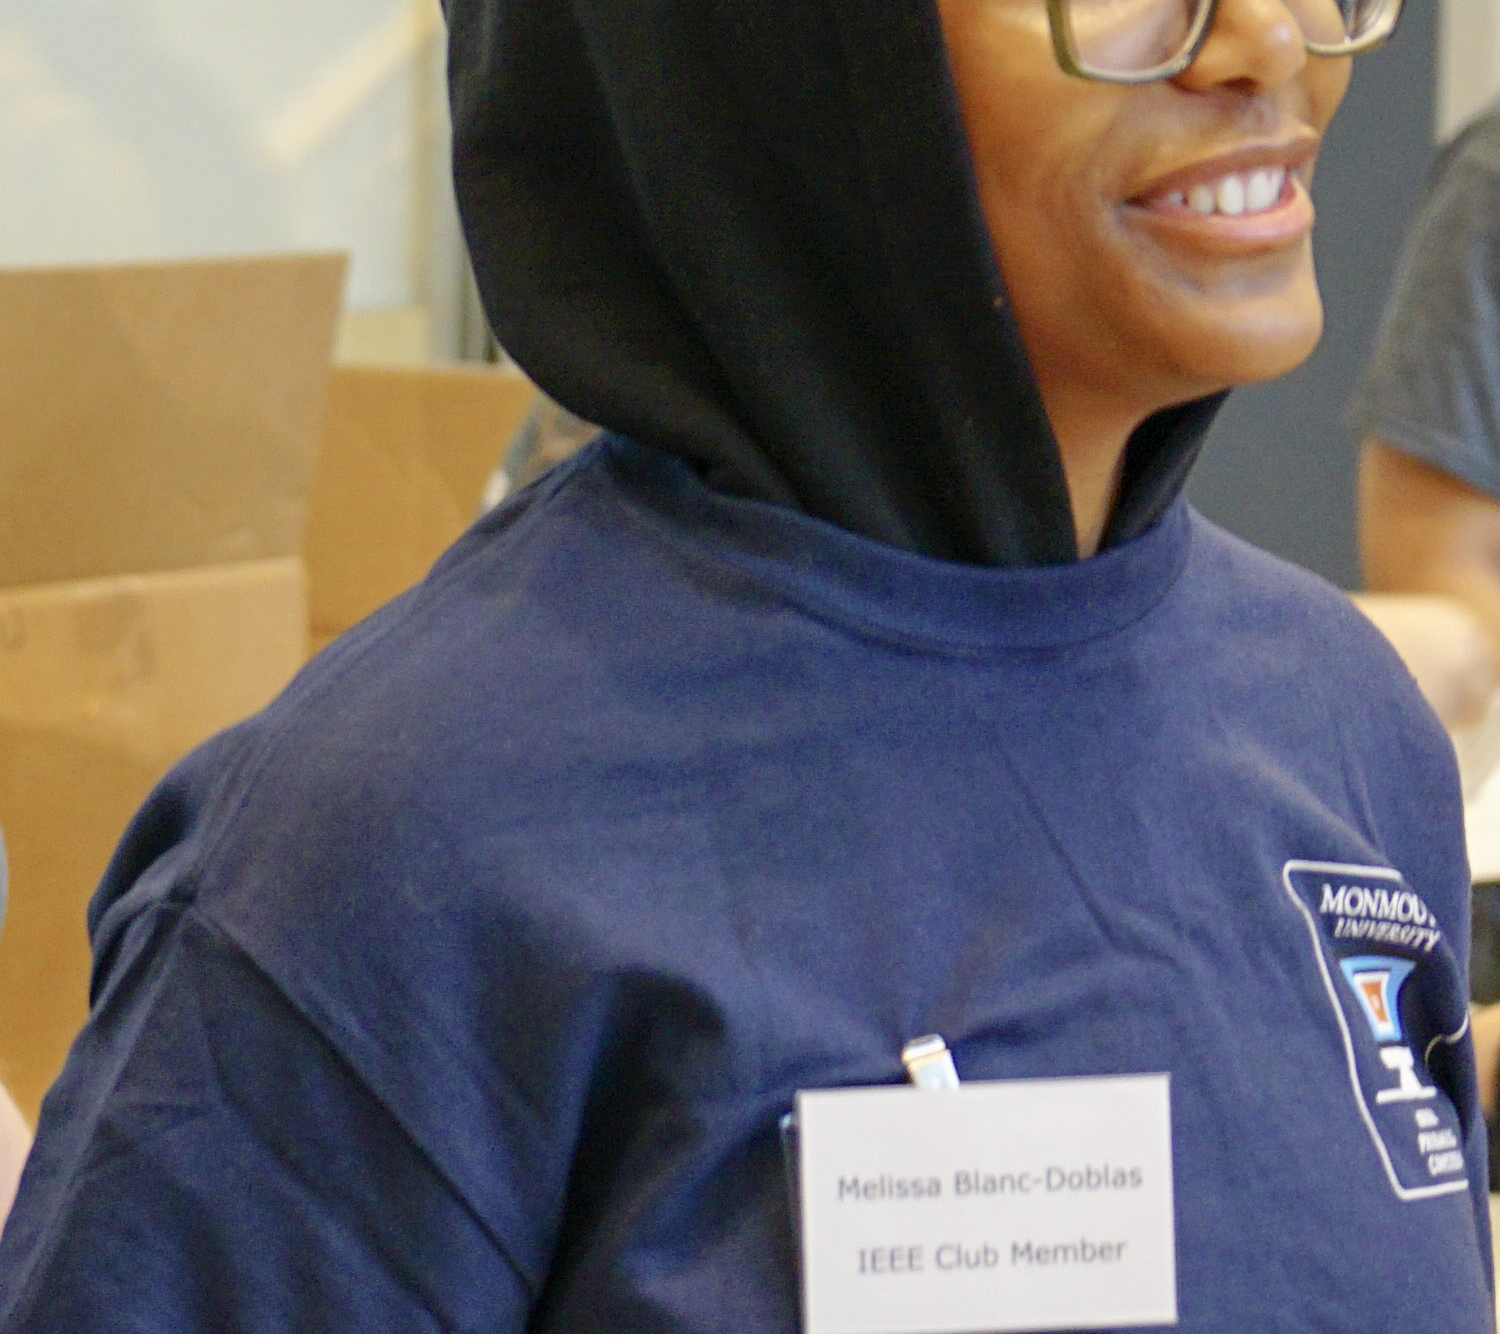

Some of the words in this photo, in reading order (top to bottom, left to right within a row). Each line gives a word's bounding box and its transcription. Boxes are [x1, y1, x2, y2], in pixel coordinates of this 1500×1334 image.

[1320, 883, 1437, 928] MONMOU
[1333, 917, 1441, 952] UNIVERSITY
[837, 1173, 942, 1202] Melissa
[954, 1163, 1143, 1196] Blanc-Doblas
[857, 1246, 924, 1276] IEEE
[935, 1242, 1000, 1271] Club
[1010, 1236, 1127, 1267] Member
